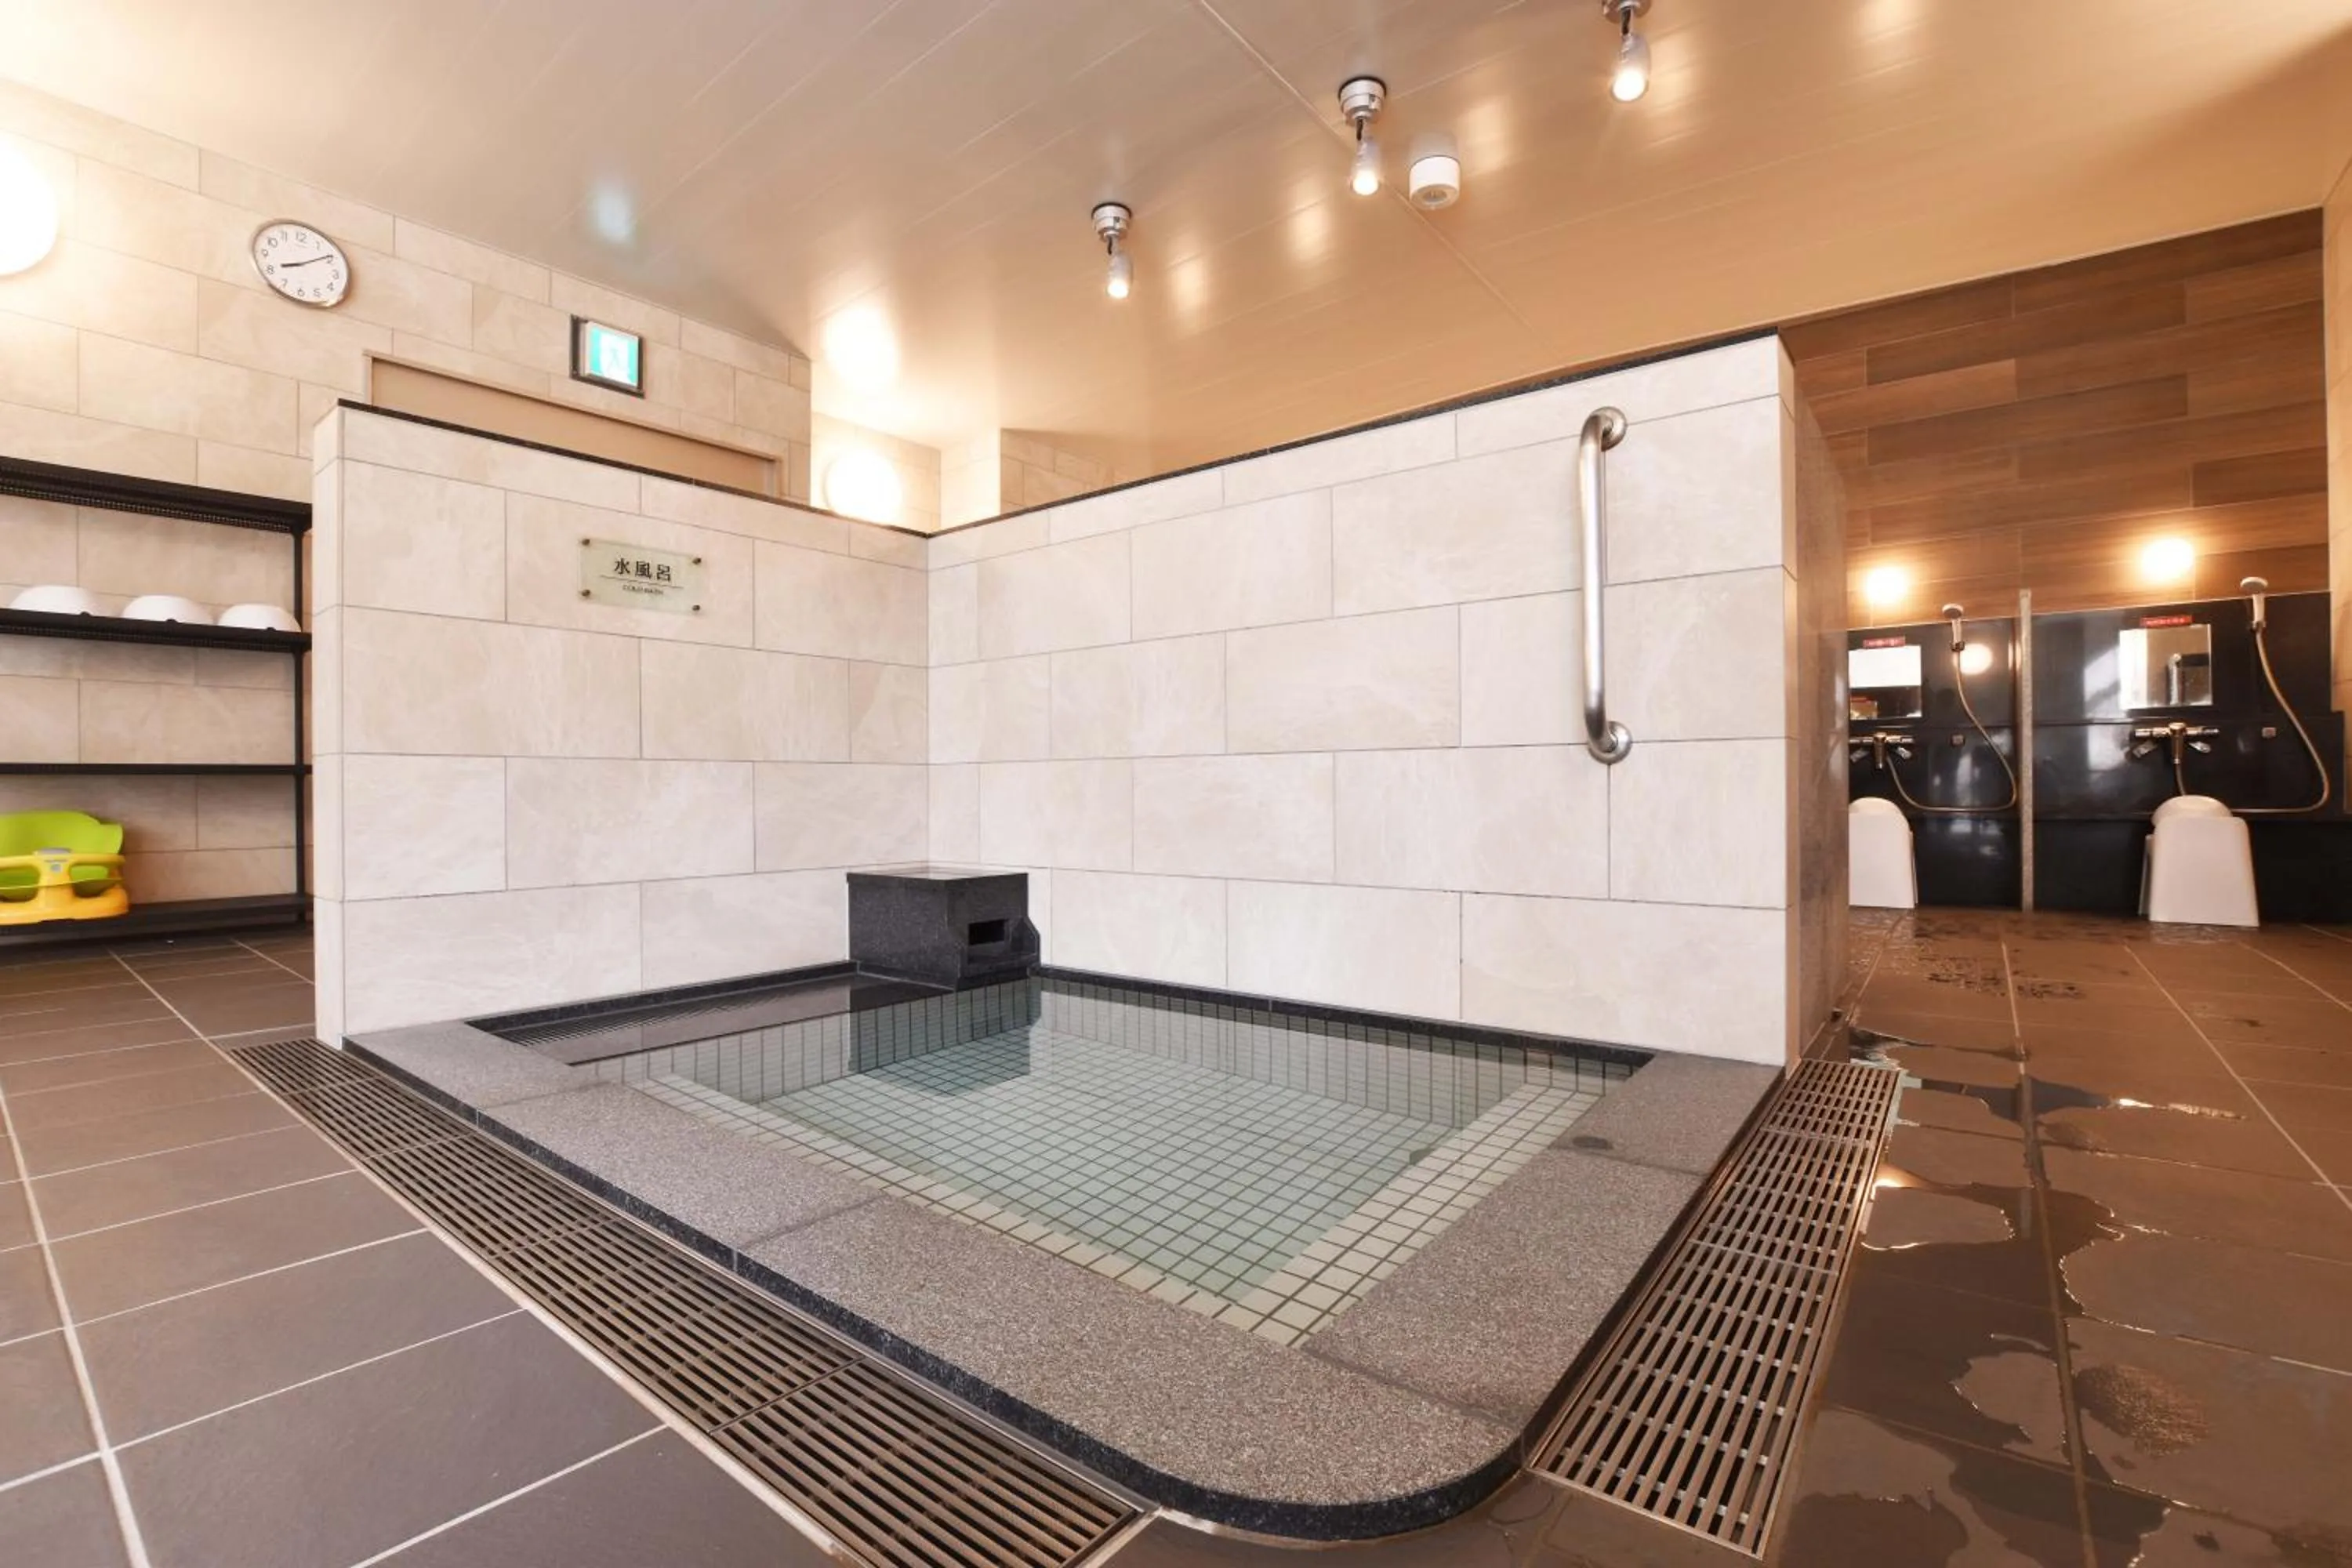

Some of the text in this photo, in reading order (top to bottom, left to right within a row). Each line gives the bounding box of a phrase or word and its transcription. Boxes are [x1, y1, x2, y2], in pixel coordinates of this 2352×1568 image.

[267, 237, 278, 249] 10
[296, 231, 307, 244] 12
[614, 557, 671, 583] 水風呂
